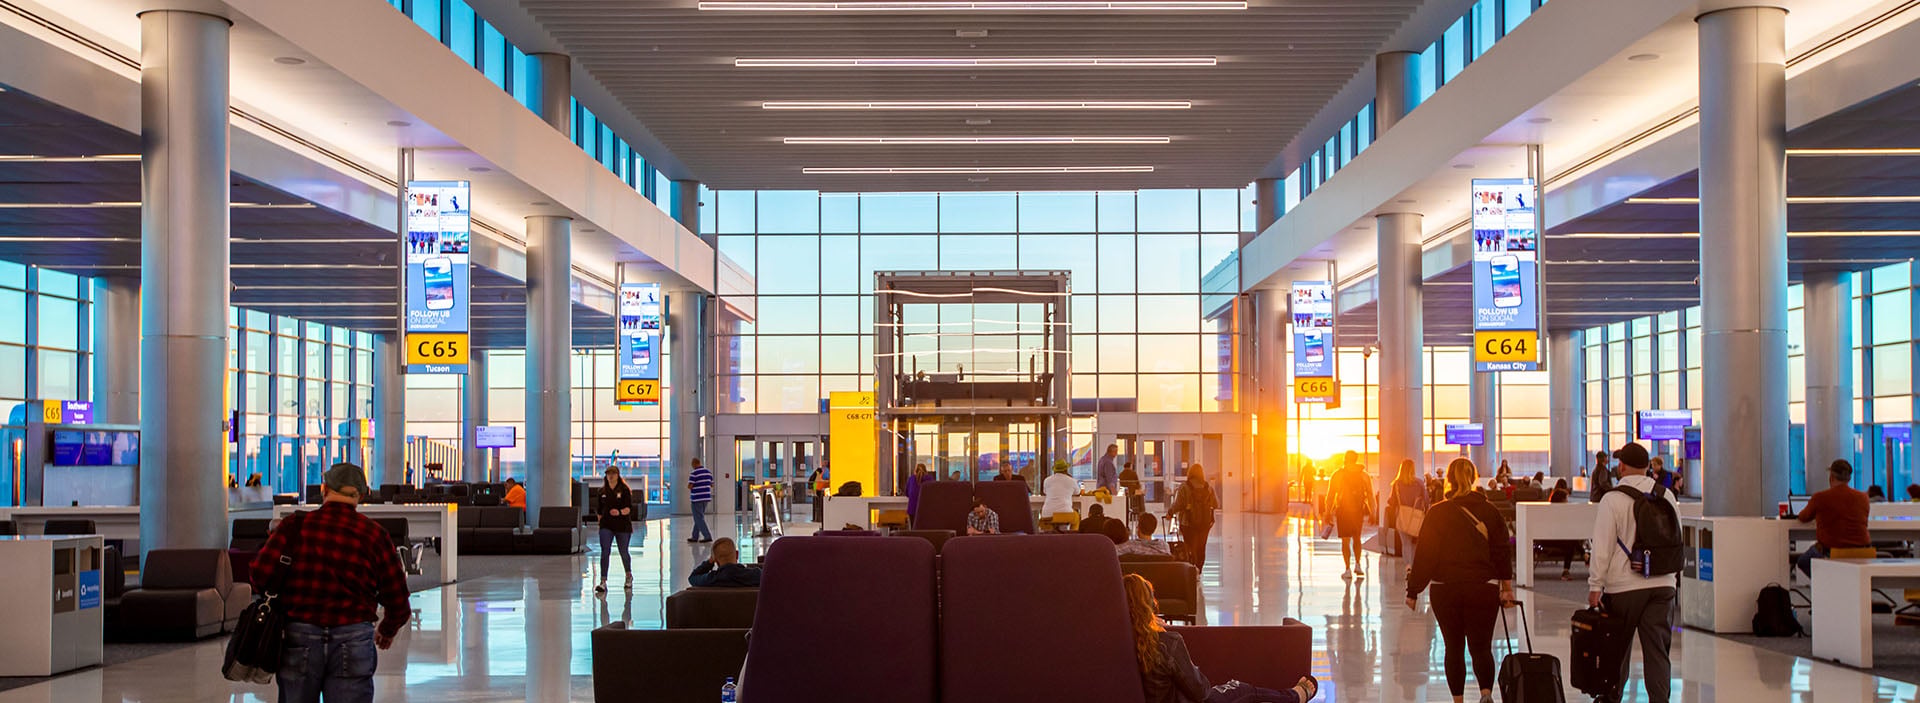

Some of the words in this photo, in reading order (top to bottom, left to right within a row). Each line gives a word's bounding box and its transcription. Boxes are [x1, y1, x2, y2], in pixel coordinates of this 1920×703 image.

[417, 341, 458, 357] C65
[1485, 338, 1527, 355] C64
[1487, 362, 1511, 370] Kansas
[1512, 362, 1527, 371] City
[627, 384, 652, 395] C67
[1301, 382, 1327, 392] C66
[45, 407, 60, 420] C65
